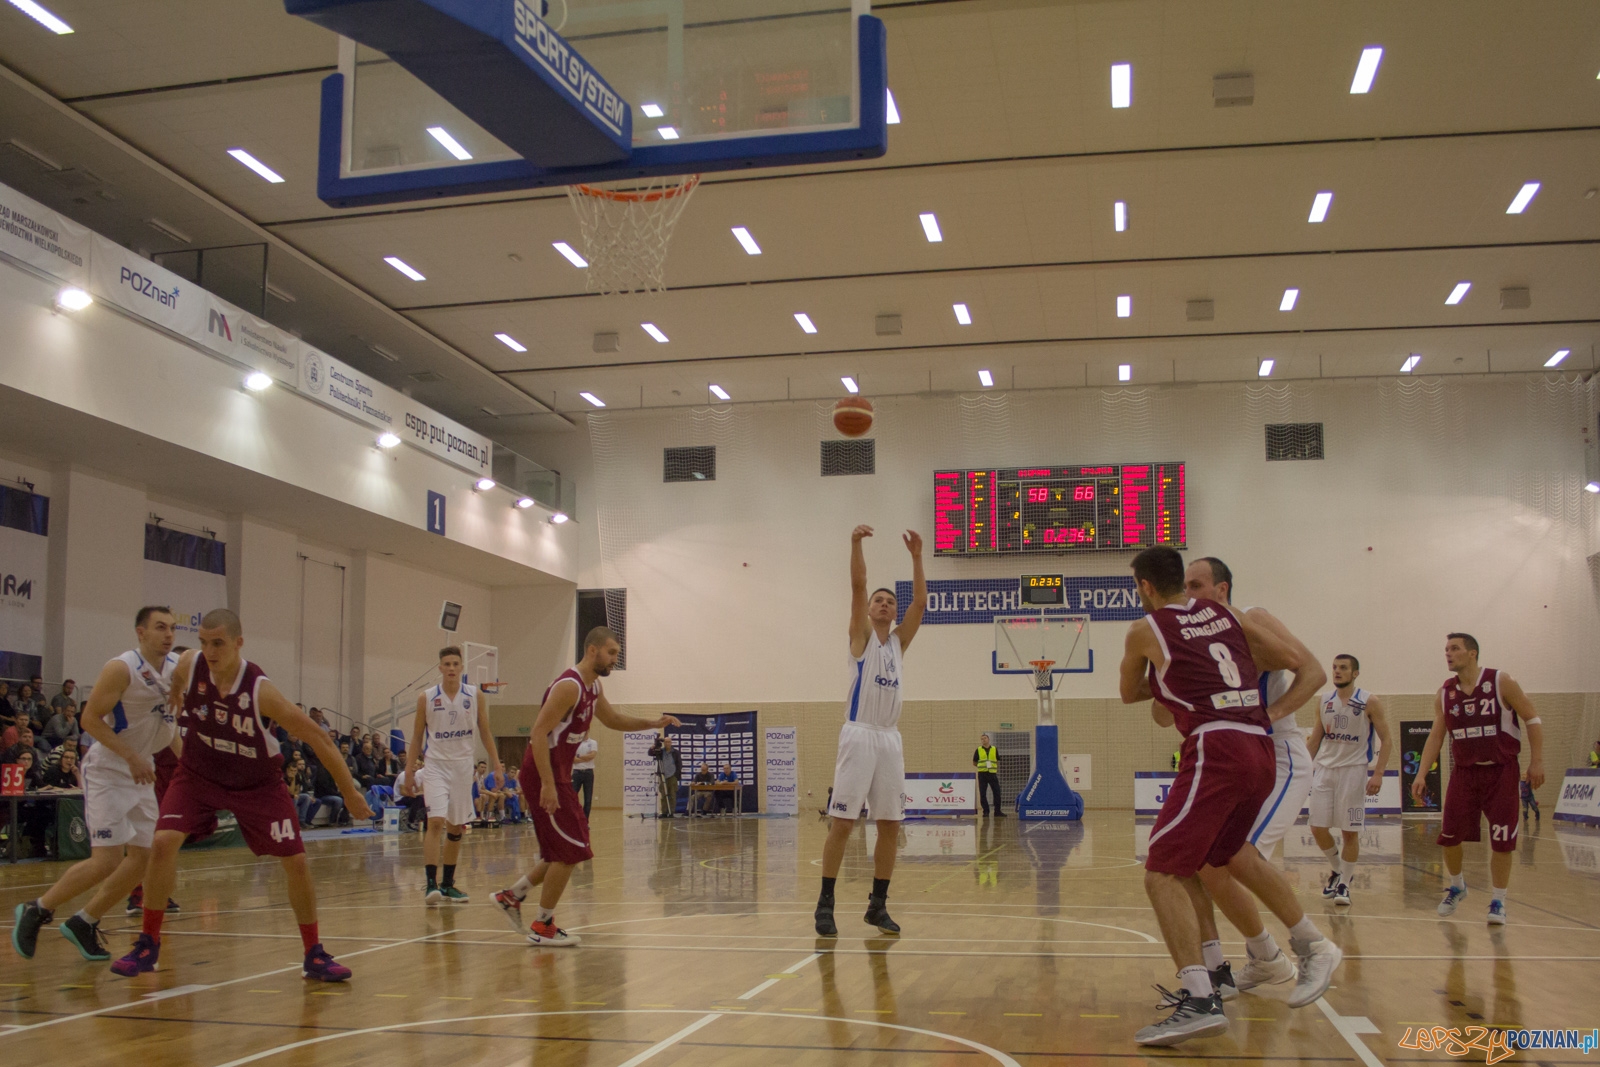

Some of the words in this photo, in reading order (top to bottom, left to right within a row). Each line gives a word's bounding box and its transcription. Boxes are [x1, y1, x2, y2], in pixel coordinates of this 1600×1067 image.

[12, 211, 59, 242] MARSZAŁKOWSKI
[34, 235, 83, 267] WIELKOPOLSKIEGO
[330, 366, 354, 388] Centrum
[355, 379, 373, 397] Sportu
[330, 384, 361, 410] Politechniki
[405, 412, 489, 468] cspp.put.poznan.pl
[1027, 487, 1049, 503] 58
[1073, 485, 1094, 501] 66
[433, 497, 442, 531] 1
[1030, 577, 1061, 588] 0.23.5
[1079, 589, 1144, 609] POZN
[1208, 642, 1242, 688] 8
[448, 710, 458, 725] 7
[1479, 697, 1496, 716] 21
[232, 713, 255, 737] 44
[1333, 714, 1349, 730] 10
[435, 729, 473, 739] BIOFARM
[1347, 807, 1363, 821] 10
[270, 818, 295, 843] 44
[1491, 823, 1509, 842] 21
